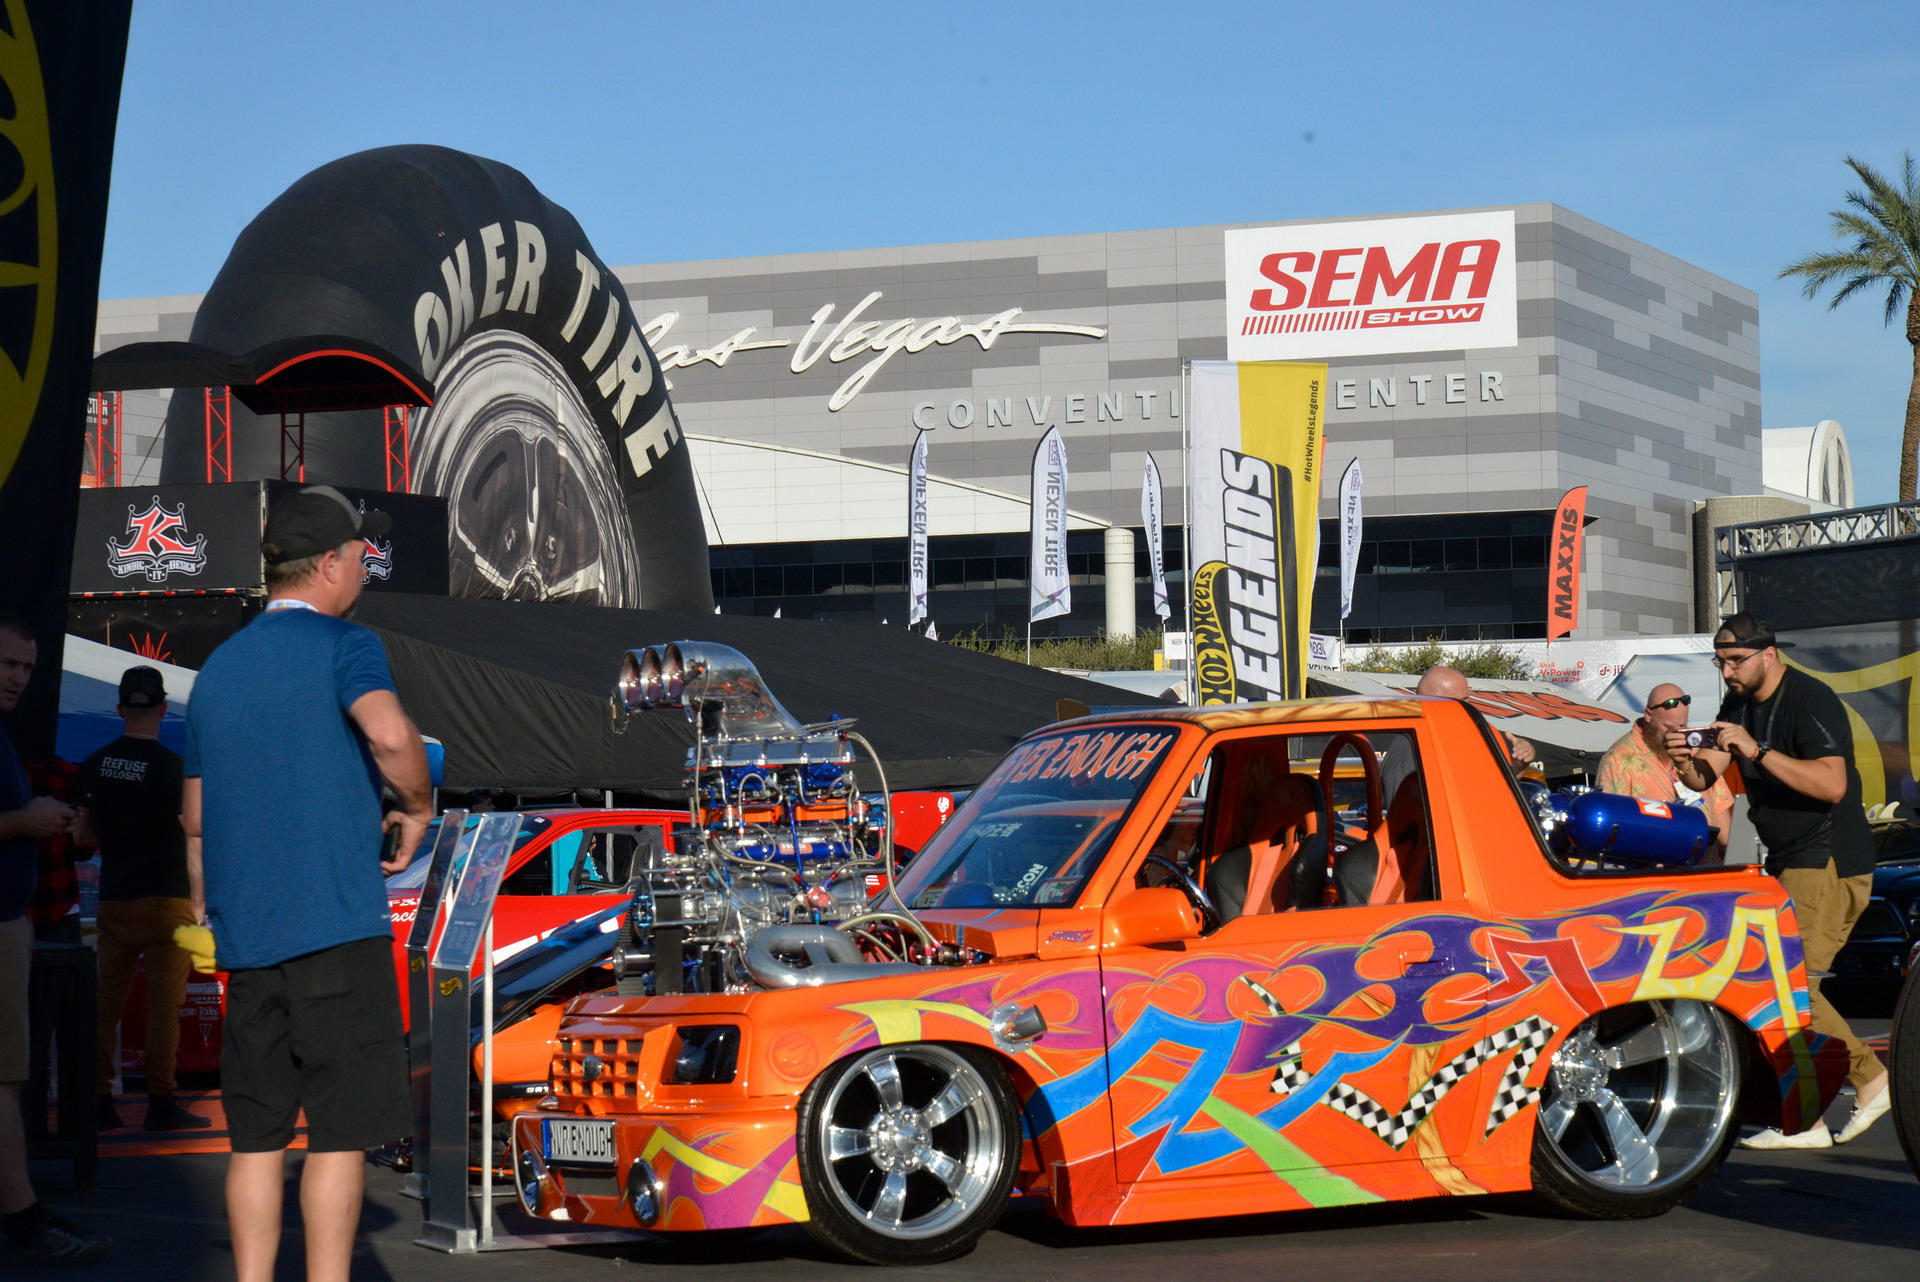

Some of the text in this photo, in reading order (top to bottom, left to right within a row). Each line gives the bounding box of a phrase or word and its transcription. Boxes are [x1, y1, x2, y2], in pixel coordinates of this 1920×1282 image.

[1249, 238, 1501, 312] SEMA
[411, 219, 679, 478] OKER TIRE
[1366, 306, 1480, 326] SHOW
[790, 291, 1108, 412] Vegas
[912, 370, 1505, 431] CONVENTI ENTER
[118, 560, 145, 575] KINDIG
[169, 560, 196, 573] DESIGN
[1222, 448, 1282, 703] EGENDS
[1554, 507, 1579, 620] MAXXIS
[102, 756, 149, 773] REFUSE
[571, 1124, 613, 1157] ENOUGH
